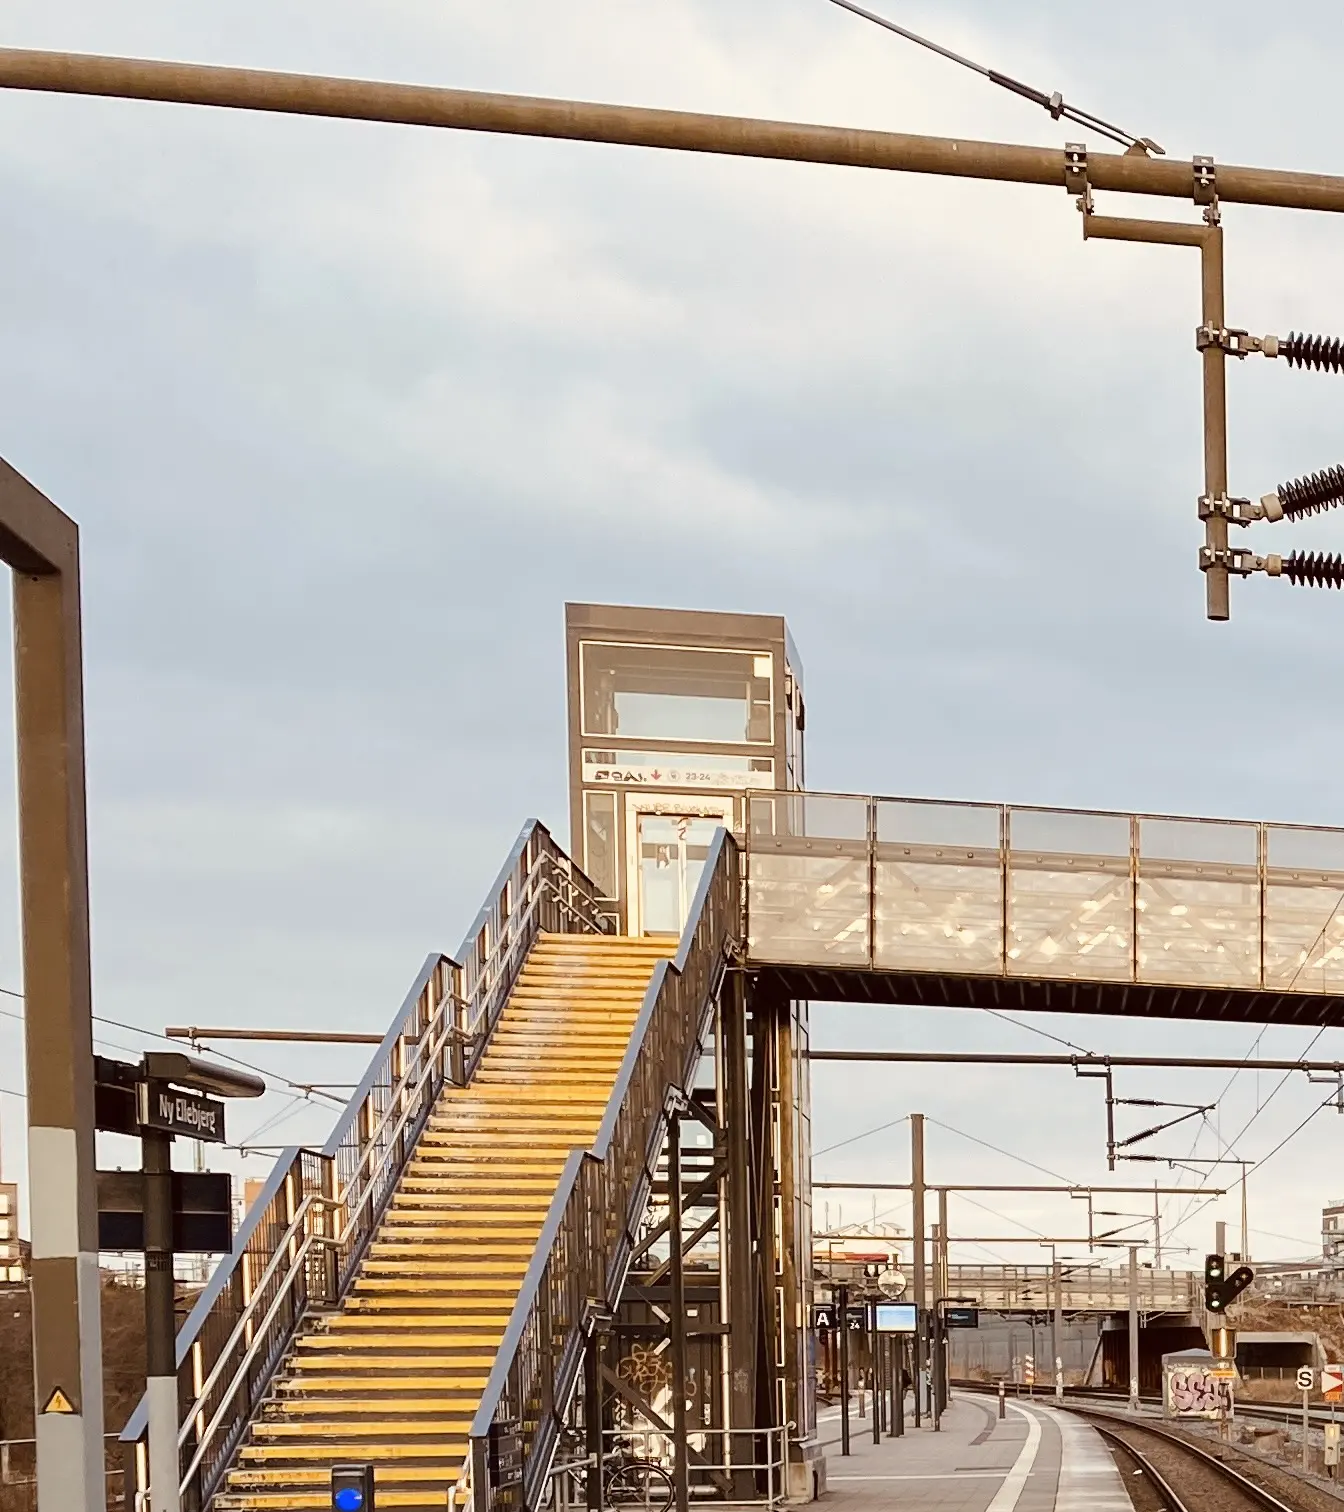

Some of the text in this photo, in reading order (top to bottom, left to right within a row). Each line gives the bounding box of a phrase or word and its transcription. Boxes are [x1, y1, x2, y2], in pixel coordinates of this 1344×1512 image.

[159, 1093, 216, 1134] Ny Ellebjerg
[816, 1312, 830, 1327] A
[1298, 1371, 1312, 1387] S
